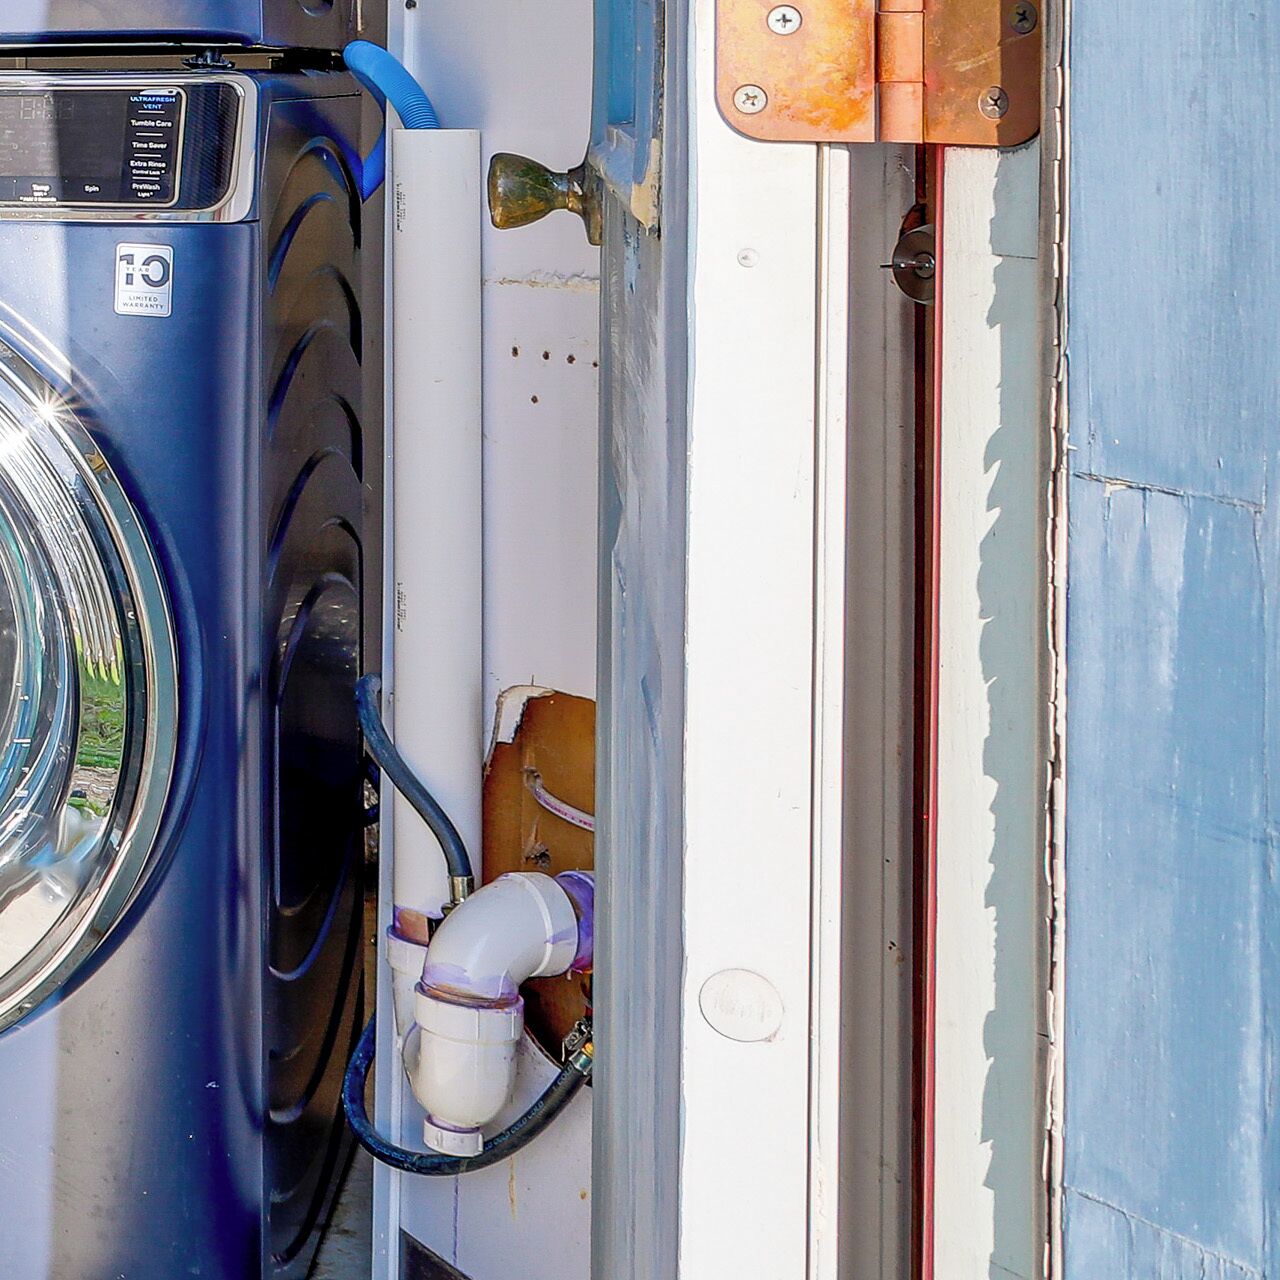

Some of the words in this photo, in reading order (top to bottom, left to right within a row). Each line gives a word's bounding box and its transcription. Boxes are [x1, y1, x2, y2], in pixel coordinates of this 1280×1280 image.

[132, 141, 148, 149] Time
[130, 160, 147, 168] Extra
[32, 184, 50, 192] Temp
[85, 185, 99, 193] Spin
[132, 183, 160, 191] PreWash
[120, 253, 171, 288] 10
[123, 302, 164, 310] WARRANTY
